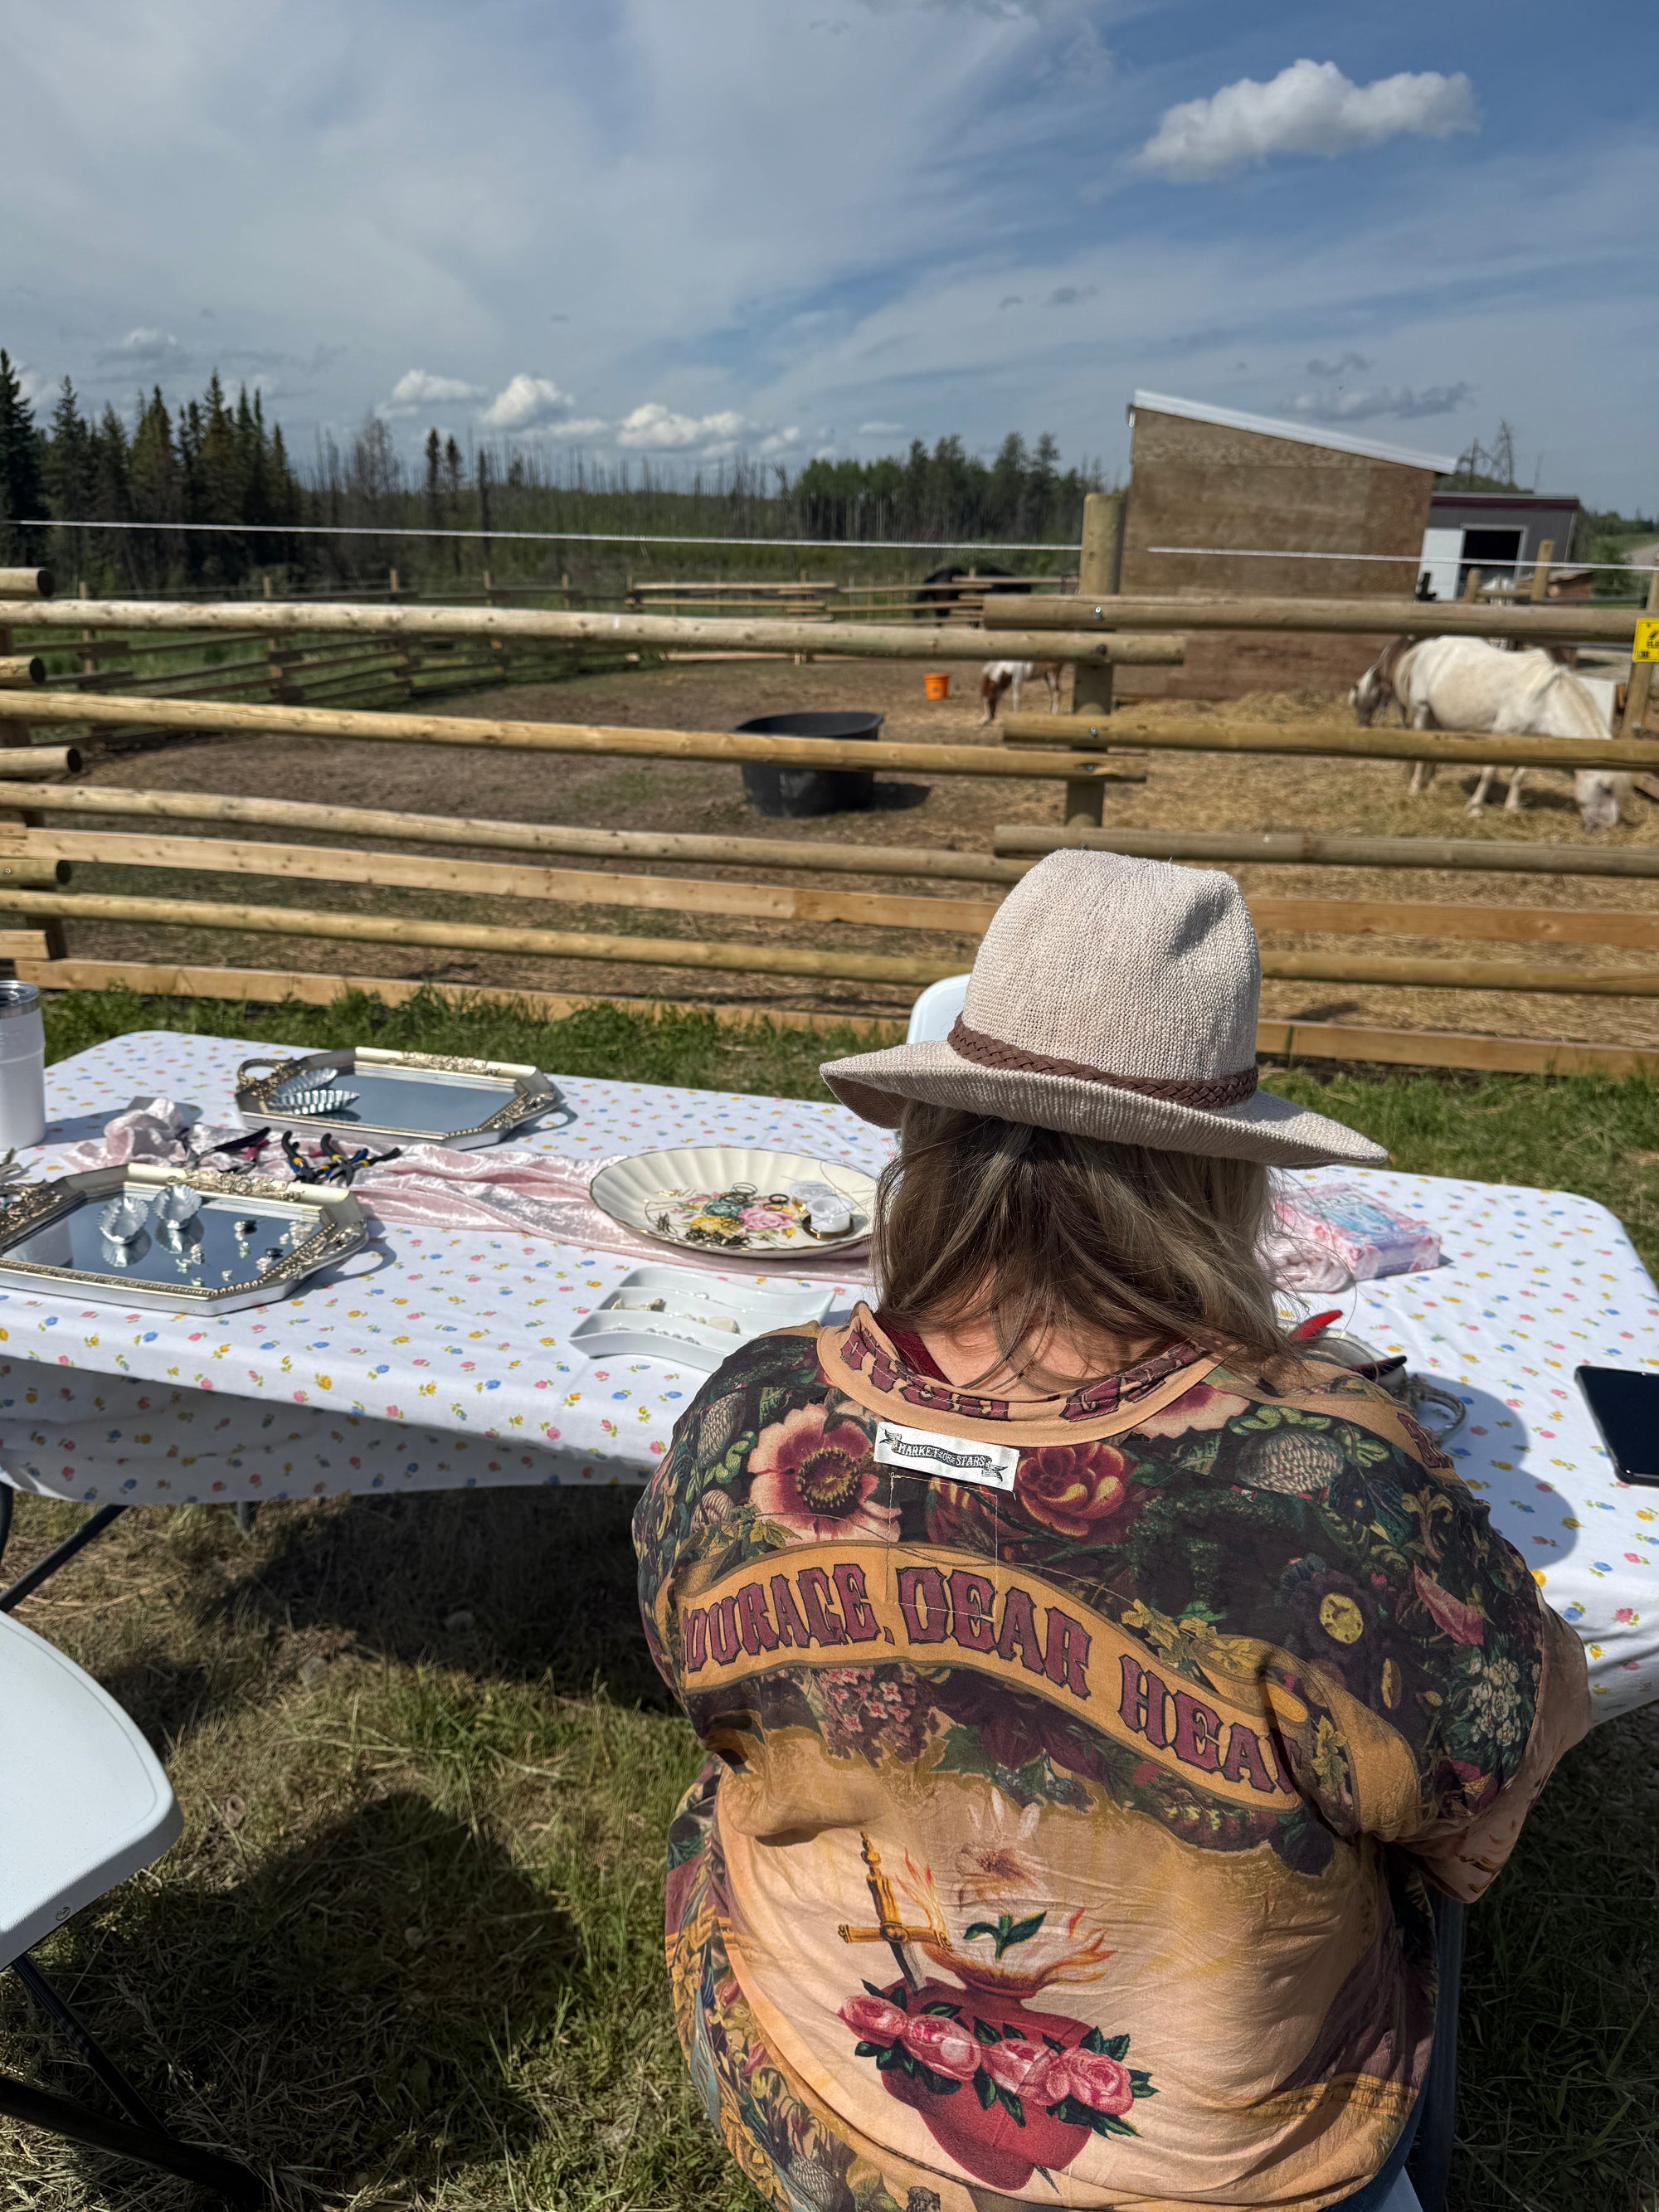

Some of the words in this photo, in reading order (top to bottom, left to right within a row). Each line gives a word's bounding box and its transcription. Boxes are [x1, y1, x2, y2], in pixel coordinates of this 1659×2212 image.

[898, 1442, 940, 1458] MARKET
[956, 1455, 985, 1466] STARS
[897, 1565, 1092, 1699] DEAR
